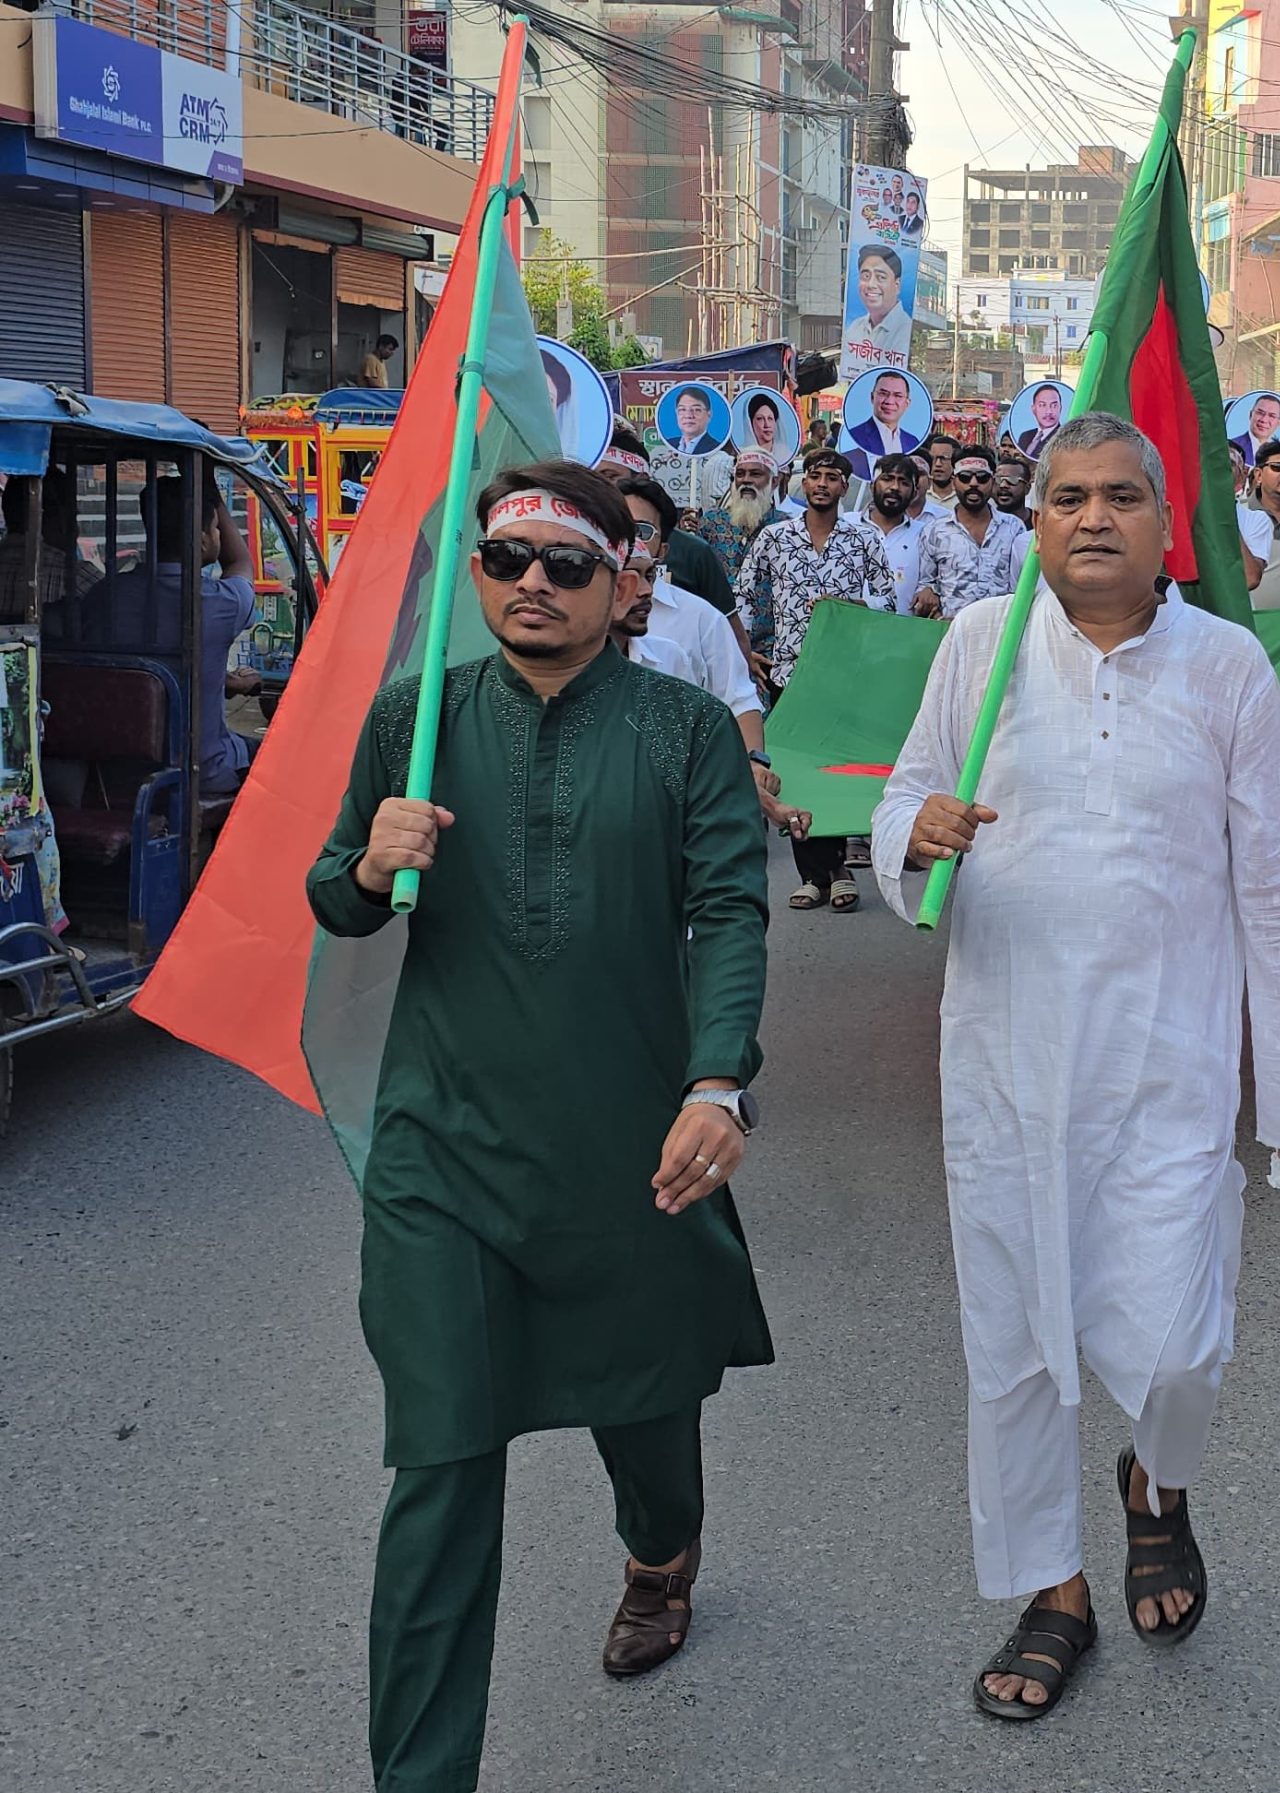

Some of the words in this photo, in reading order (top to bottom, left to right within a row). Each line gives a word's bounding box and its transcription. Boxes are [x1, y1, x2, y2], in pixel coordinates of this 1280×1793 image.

[101, 104, 122, 126] Islami
[122, 110, 140, 130] Bank
[180, 93, 211, 123] ATM
[179, 117, 211, 144] CRM
[847, 339, 883, 363] সজীব
[884, 349, 906, 367] খান
